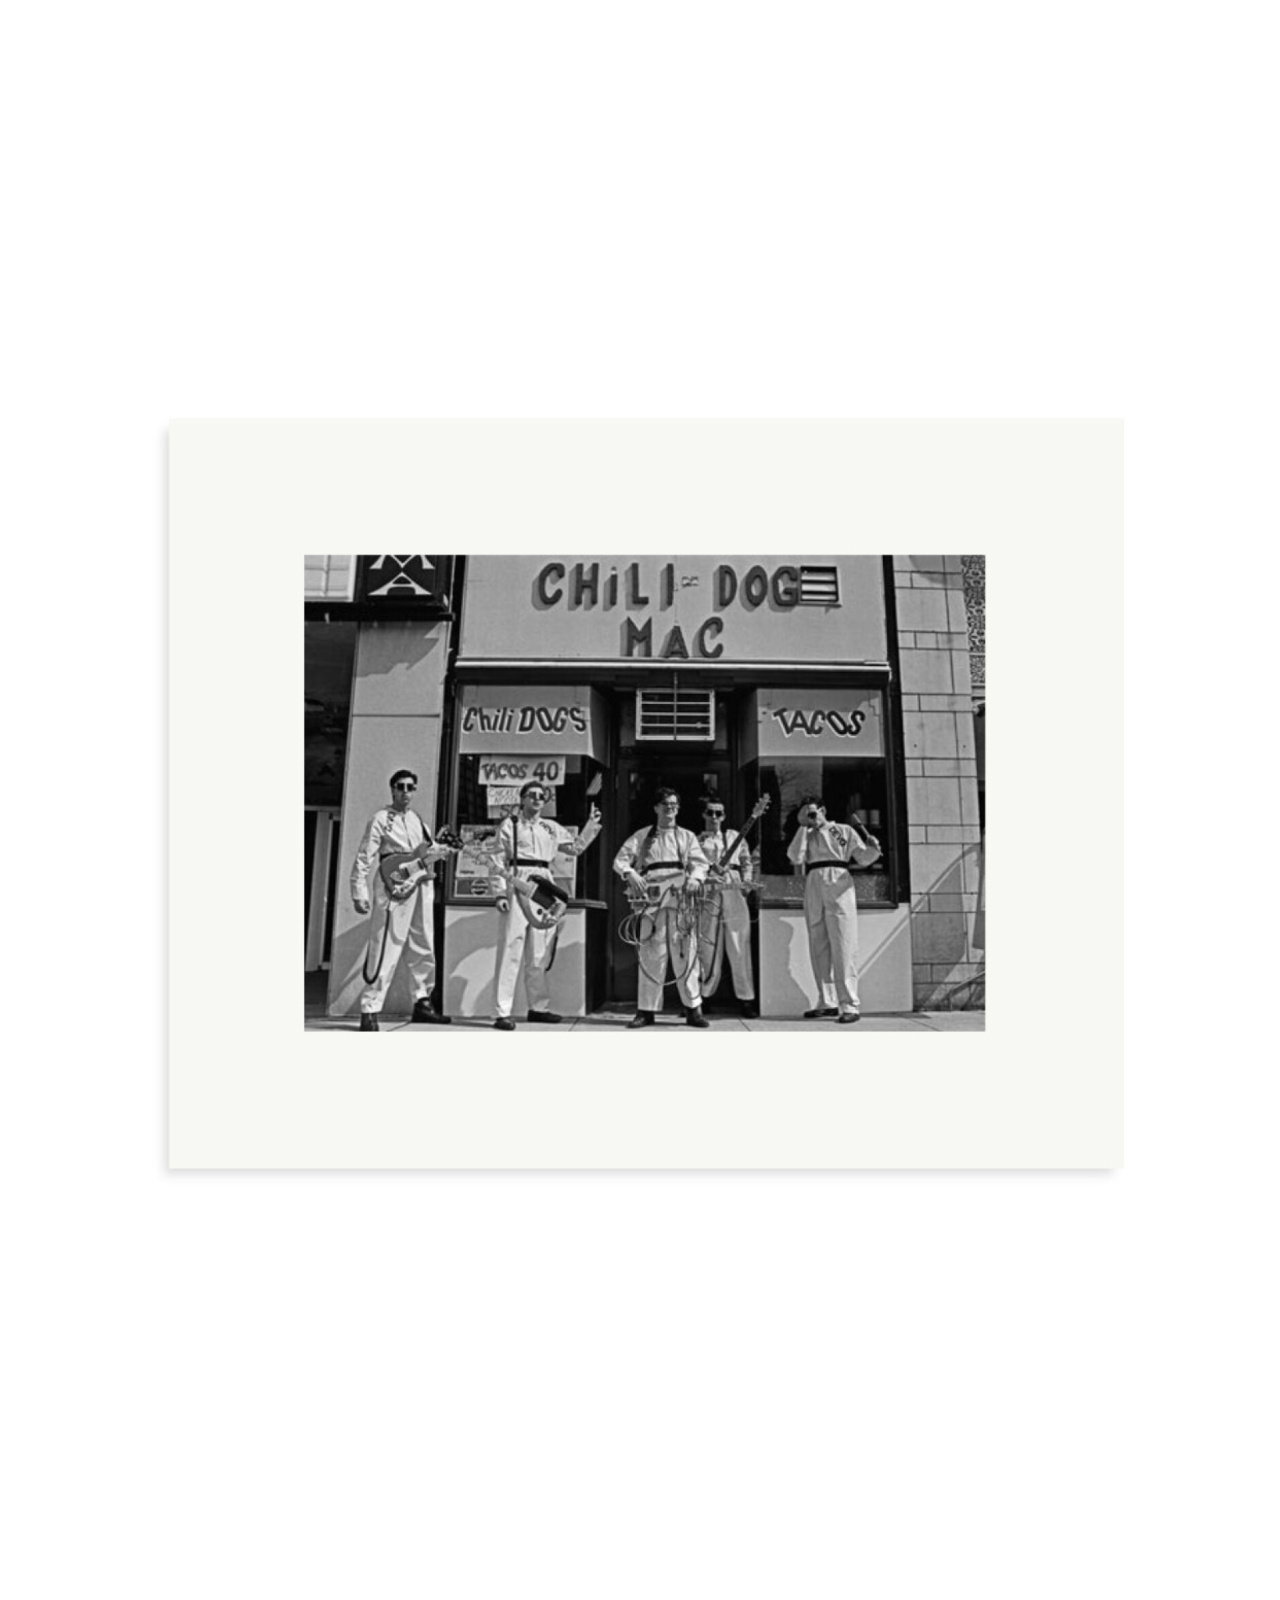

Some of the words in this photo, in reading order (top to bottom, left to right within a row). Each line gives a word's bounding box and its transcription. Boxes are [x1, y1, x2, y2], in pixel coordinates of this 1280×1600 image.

[715, 564, 801, 610] DOG
[622, 615, 725, 659] MAC
[462, 706, 515, 734] Chili
[517, 706, 587, 734] DOGS
[773, 708, 866, 738] TACOS
[481, 762, 529, 781] TACOS
[532, 760, 559, 782] 40
